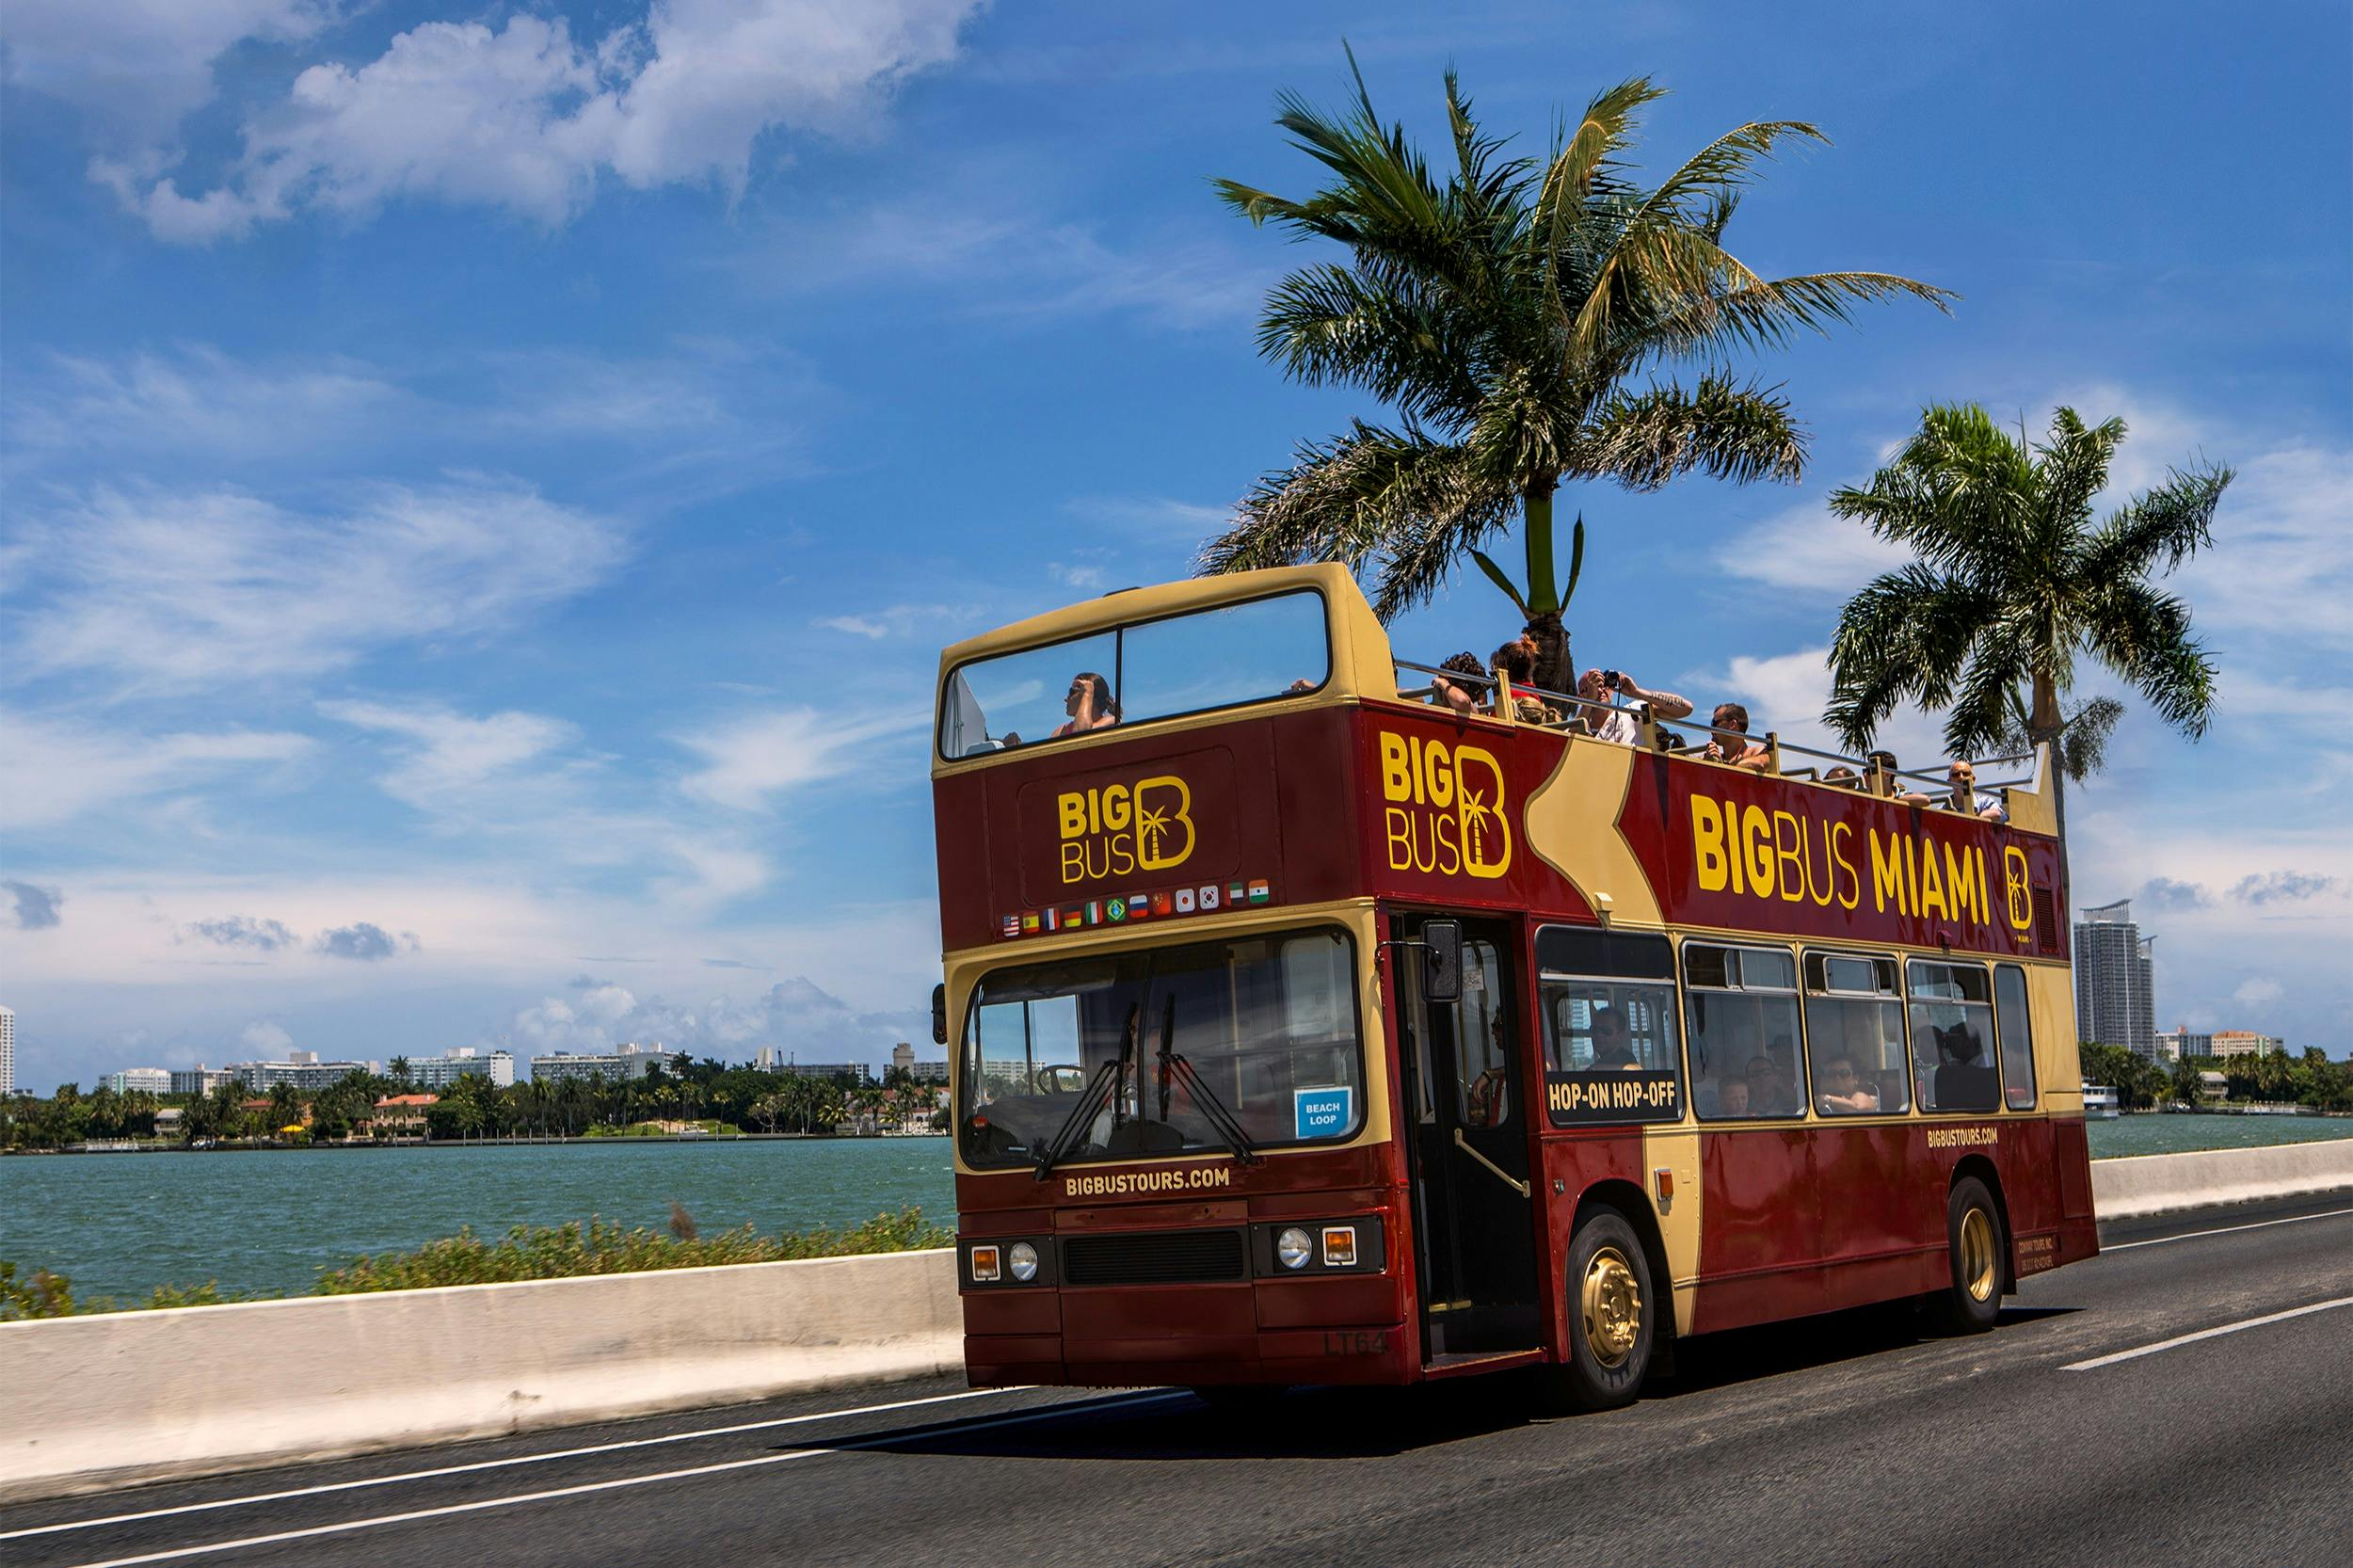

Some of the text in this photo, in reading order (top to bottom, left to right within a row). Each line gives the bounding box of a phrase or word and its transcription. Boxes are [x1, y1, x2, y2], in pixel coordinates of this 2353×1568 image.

[1379, 730, 1454, 808] BIG
[1058, 784, 1131, 840] BIG
[1385, 807, 1461, 875] BUS
[1061, 833, 1135, 884] BUS
[1868, 827, 1991, 925] MIAMI
[1305, 1102, 1340, 1113] BEACH
[1548, 1081, 1675, 1111] HOP-ON HOP-OFF
[1309, 1114, 1337, 1126] LOOP
[1927, 1128, 1998, 1148] BIGBUSTOURS.COM
[1065, 1167, 1230, 1196] BIGBUSTOURS.COM
[1323, 1328, 1388, 1356] LT64
